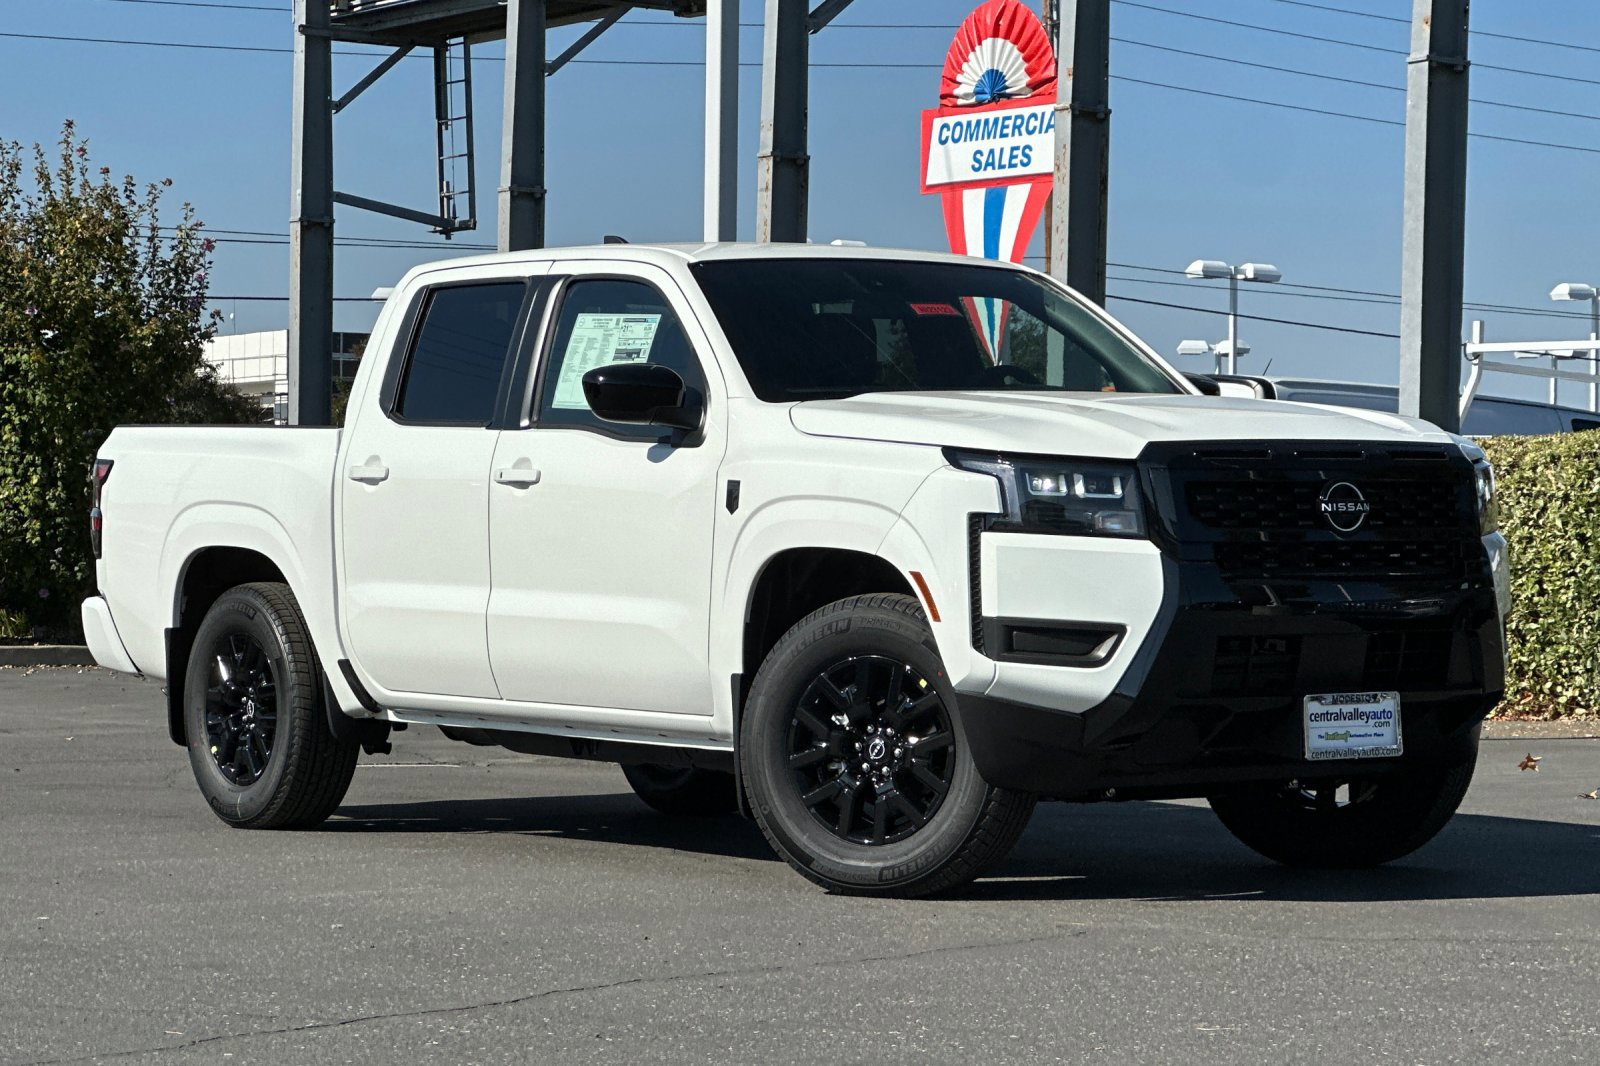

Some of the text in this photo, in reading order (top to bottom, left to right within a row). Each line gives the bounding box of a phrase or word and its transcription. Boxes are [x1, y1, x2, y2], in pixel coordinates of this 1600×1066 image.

[971, 144, 1033, 173] SALES
[1321, 502, 1370, 512] NISSAN
[1309, 708, 1393, 723] centralvalleyauto
[1311, 747, 1399, 760] centralvalleyauto.com
